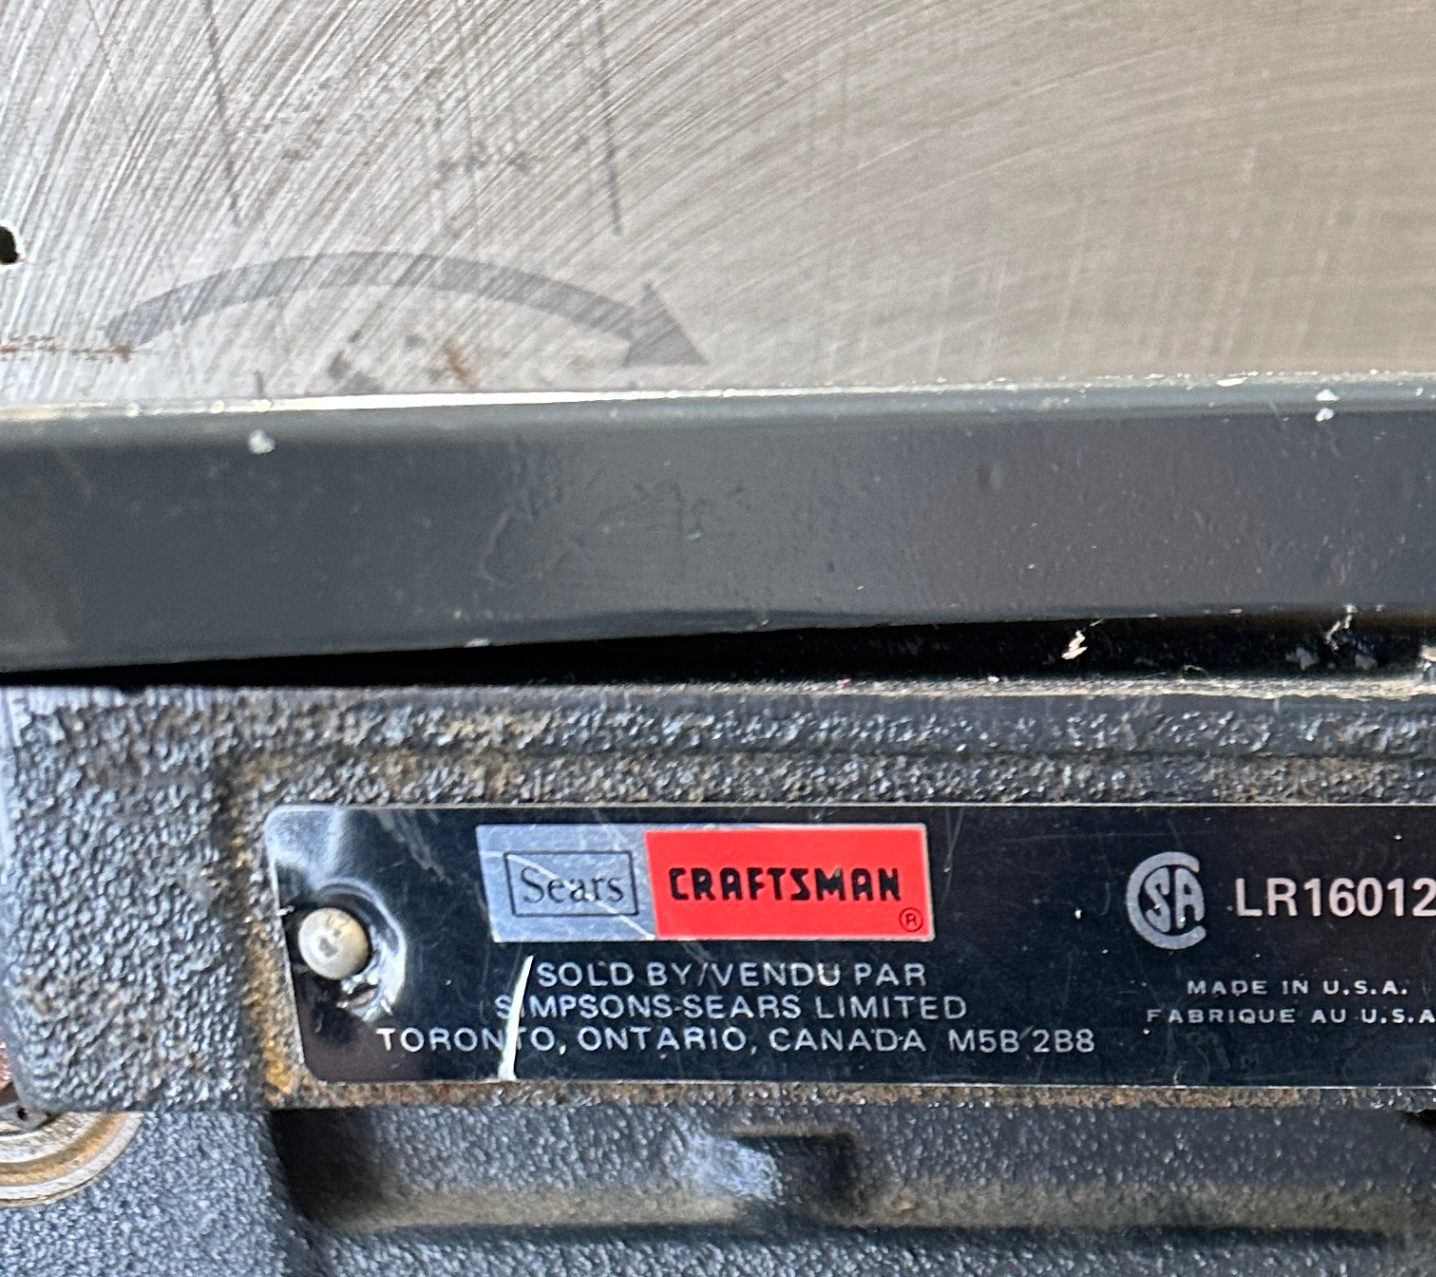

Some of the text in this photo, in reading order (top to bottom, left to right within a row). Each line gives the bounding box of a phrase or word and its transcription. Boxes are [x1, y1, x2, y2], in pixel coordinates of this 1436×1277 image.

[521, 866, 901, 903] Sears CRAFTSMAN
[537, 961, 927, 987] SOLD BY/VENDU PAR
[1187, 979, 1408, 997] MADE IN U.S.A.
[815, 996, 967, 1020] LIMITED
[1146, 1008, 1296, 1025] FABRIQUE
[1311, 1008, 1347, 1023] AU
[376, 1027, 1096, 1056] TORONTO, ONTARIO, CANADA M5B 2B8
